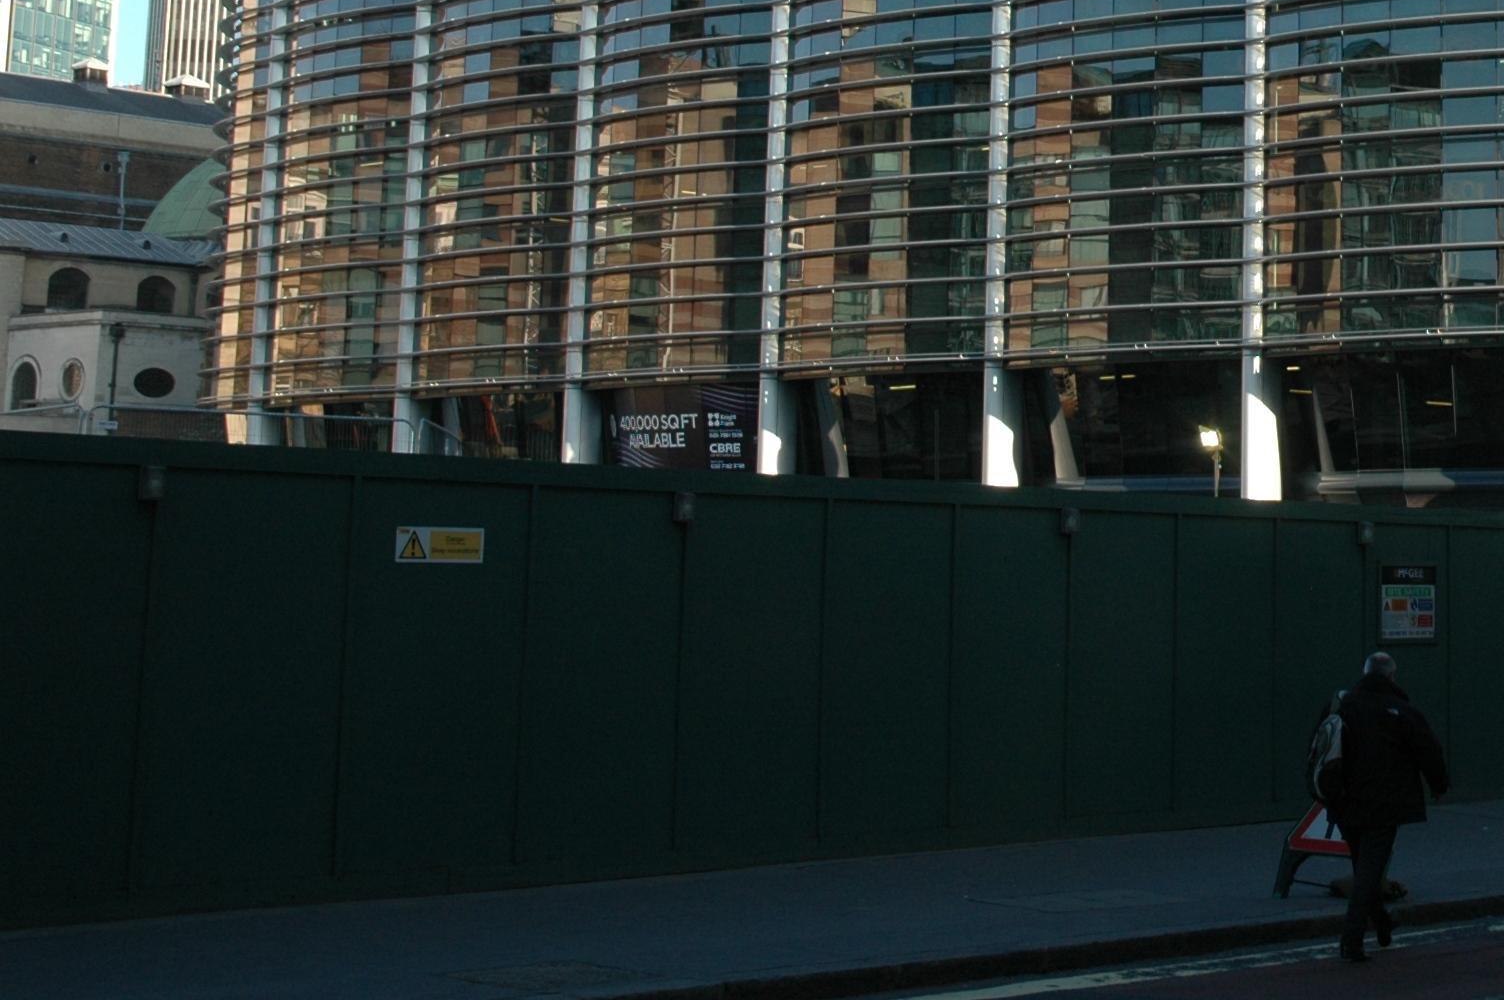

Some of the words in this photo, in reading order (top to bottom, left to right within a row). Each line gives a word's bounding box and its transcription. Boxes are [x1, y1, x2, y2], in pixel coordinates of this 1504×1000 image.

[620, 414, 660, 431] 400,000
[660, 413, 680, 430] SQ
[681, 412, 698, 429] FT
[629, 432, 686, 448] AVAILABLE
[709, 442, 741, 453] CBRE
